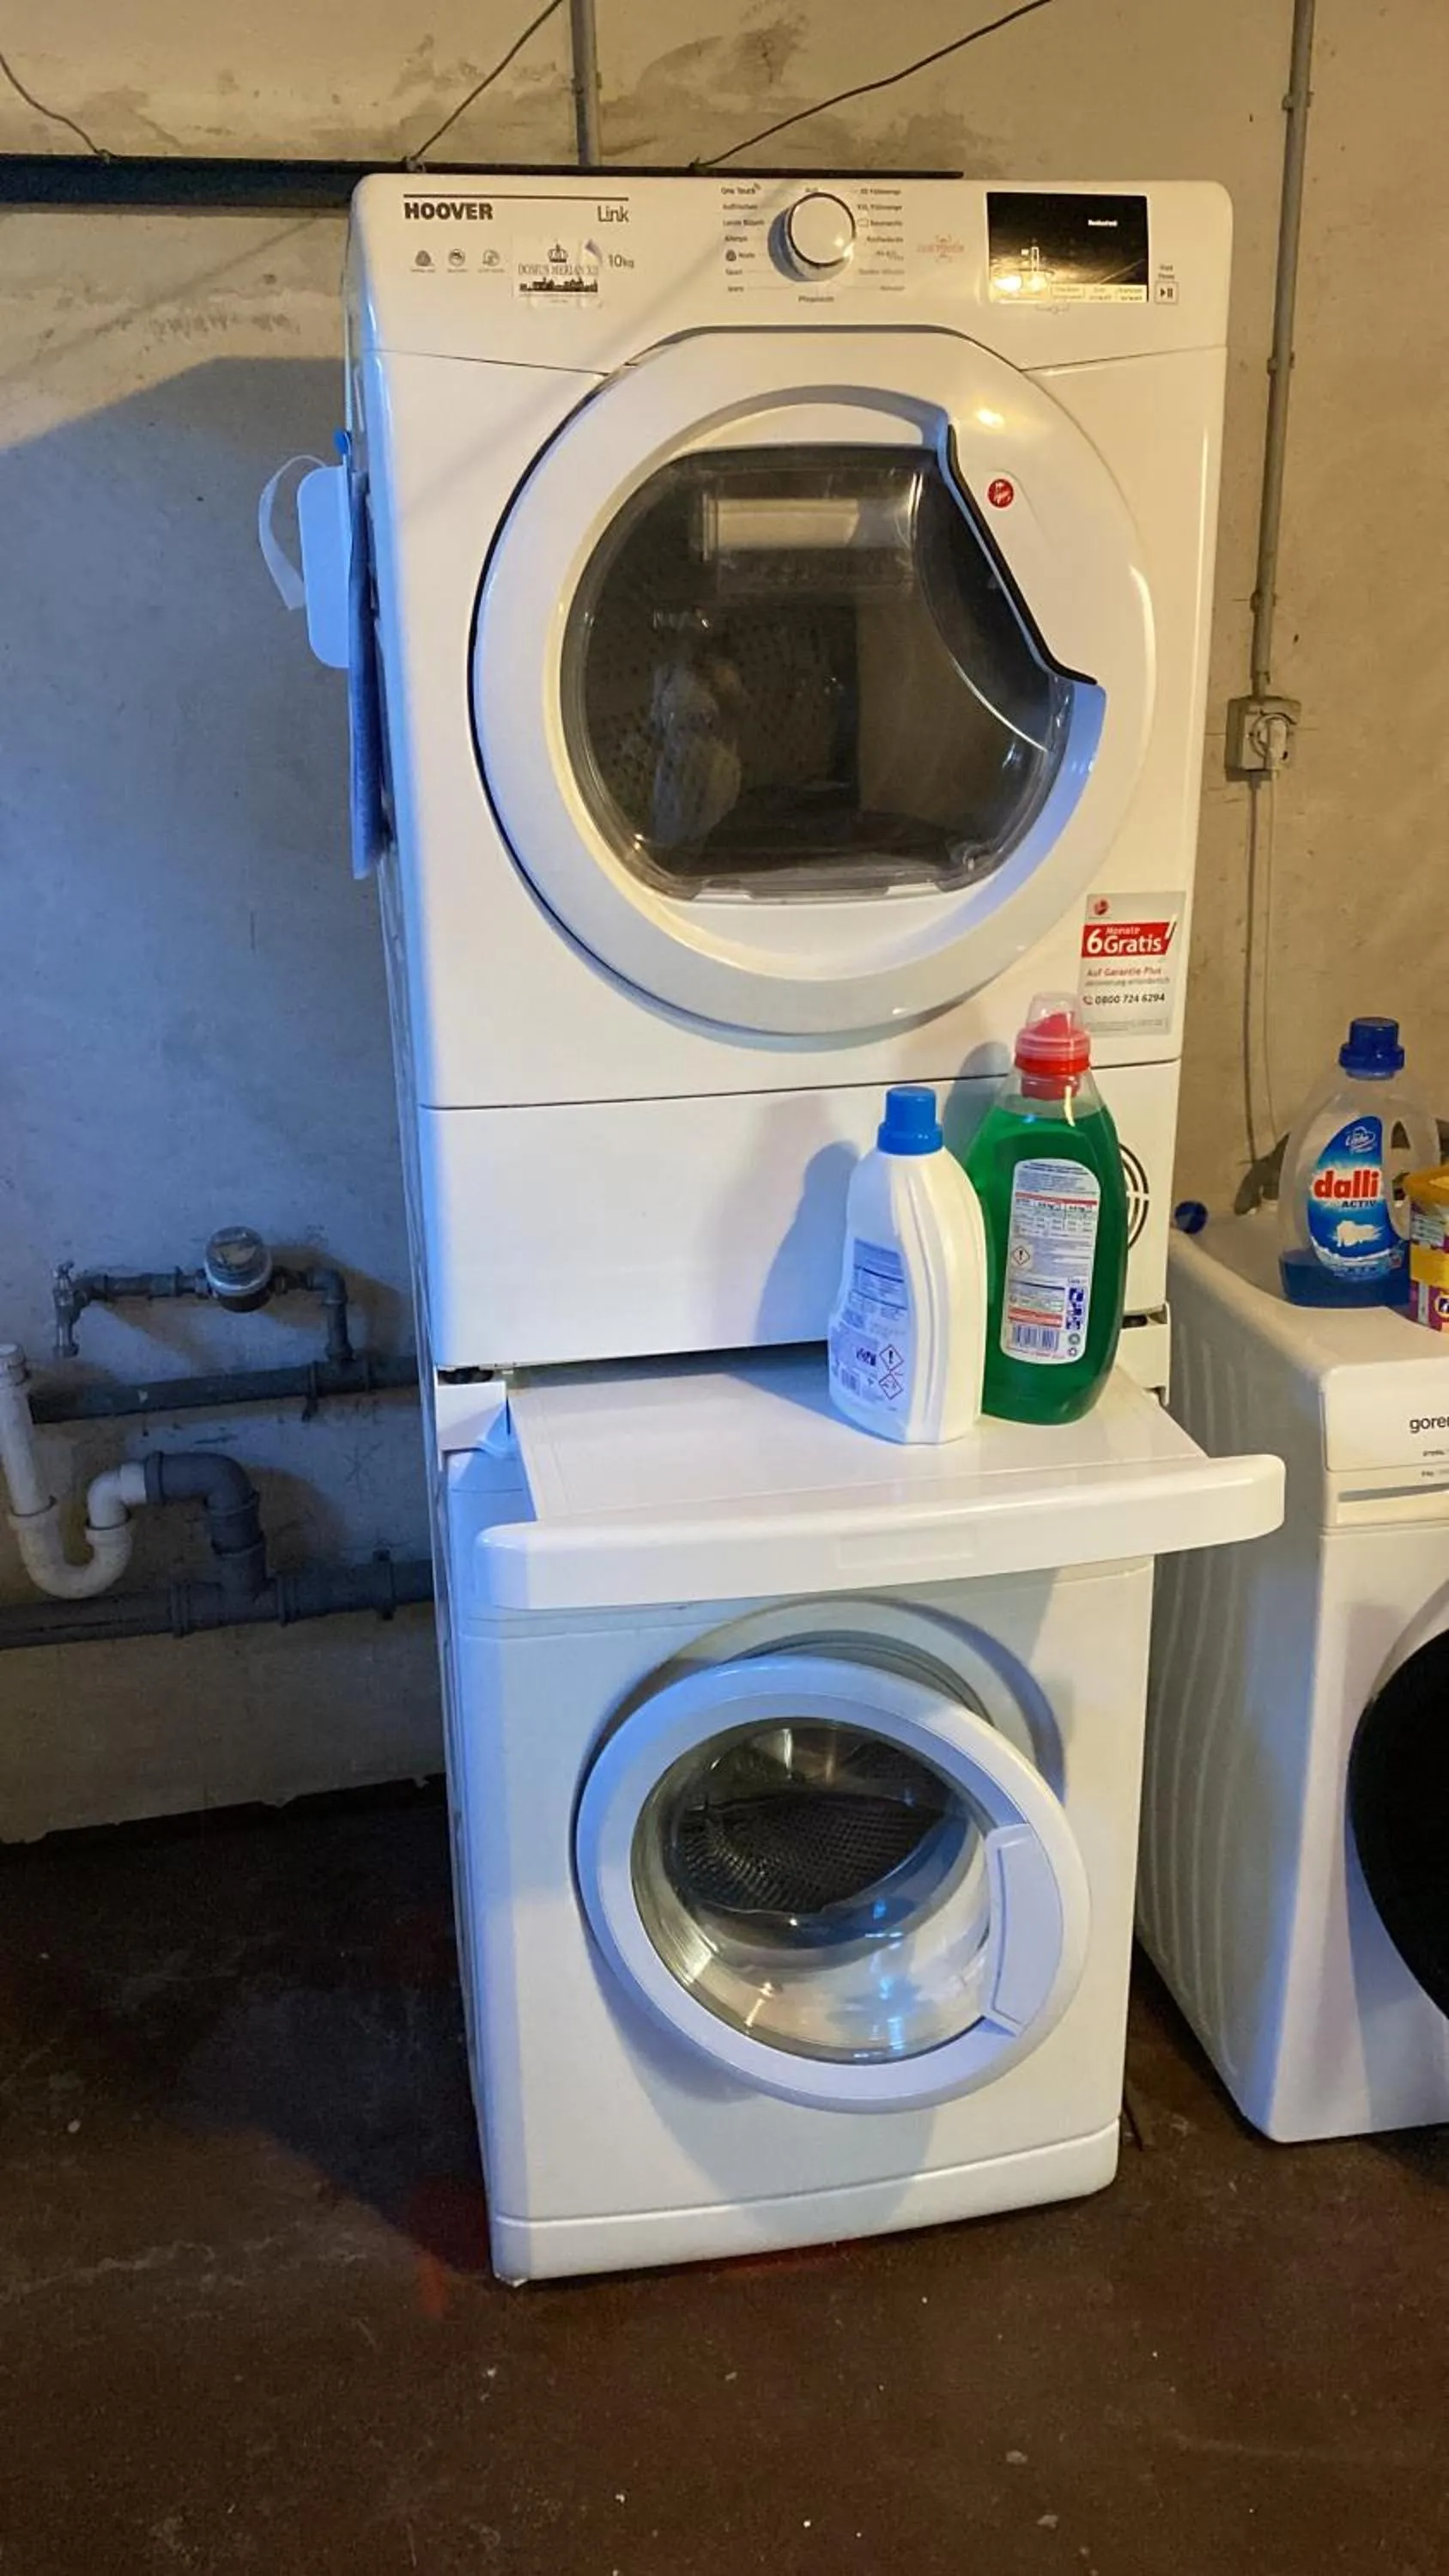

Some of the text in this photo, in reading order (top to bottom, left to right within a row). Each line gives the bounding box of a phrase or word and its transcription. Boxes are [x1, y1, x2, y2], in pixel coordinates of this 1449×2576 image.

[403, 202, 494, 221] HOOVER
[597, 205, 629, 222] Link
[608, 253, 634, 269] 10kg
[1086, 928, 1103, 954] 6
[1087, 966, 1162, 977] Auf Garantie Plus
[1094, 993, 1166, 1005] 0800 724 6294
[1313, 1169, 1379, 1200] dalli
